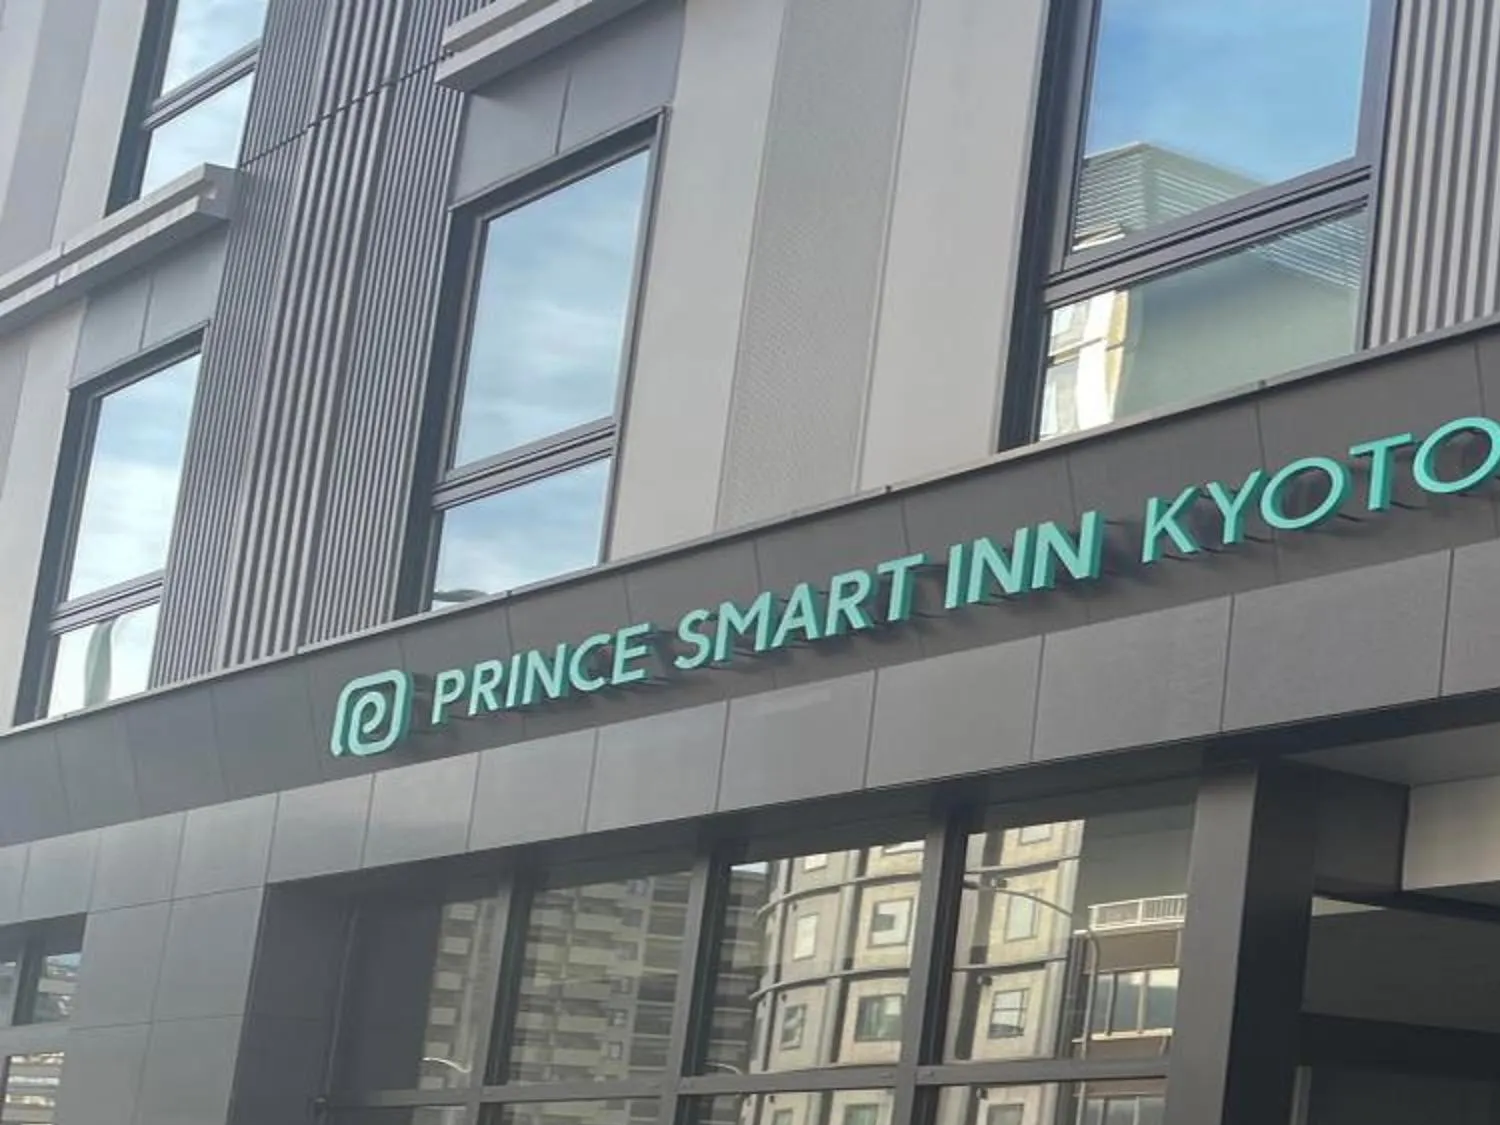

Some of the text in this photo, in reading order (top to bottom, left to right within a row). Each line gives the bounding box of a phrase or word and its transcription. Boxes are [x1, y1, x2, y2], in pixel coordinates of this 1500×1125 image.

[431, 622, 650, 725] PRINCE
[674, 553, 925, 671] SMART
[944, 510, 1105, 610] INN
